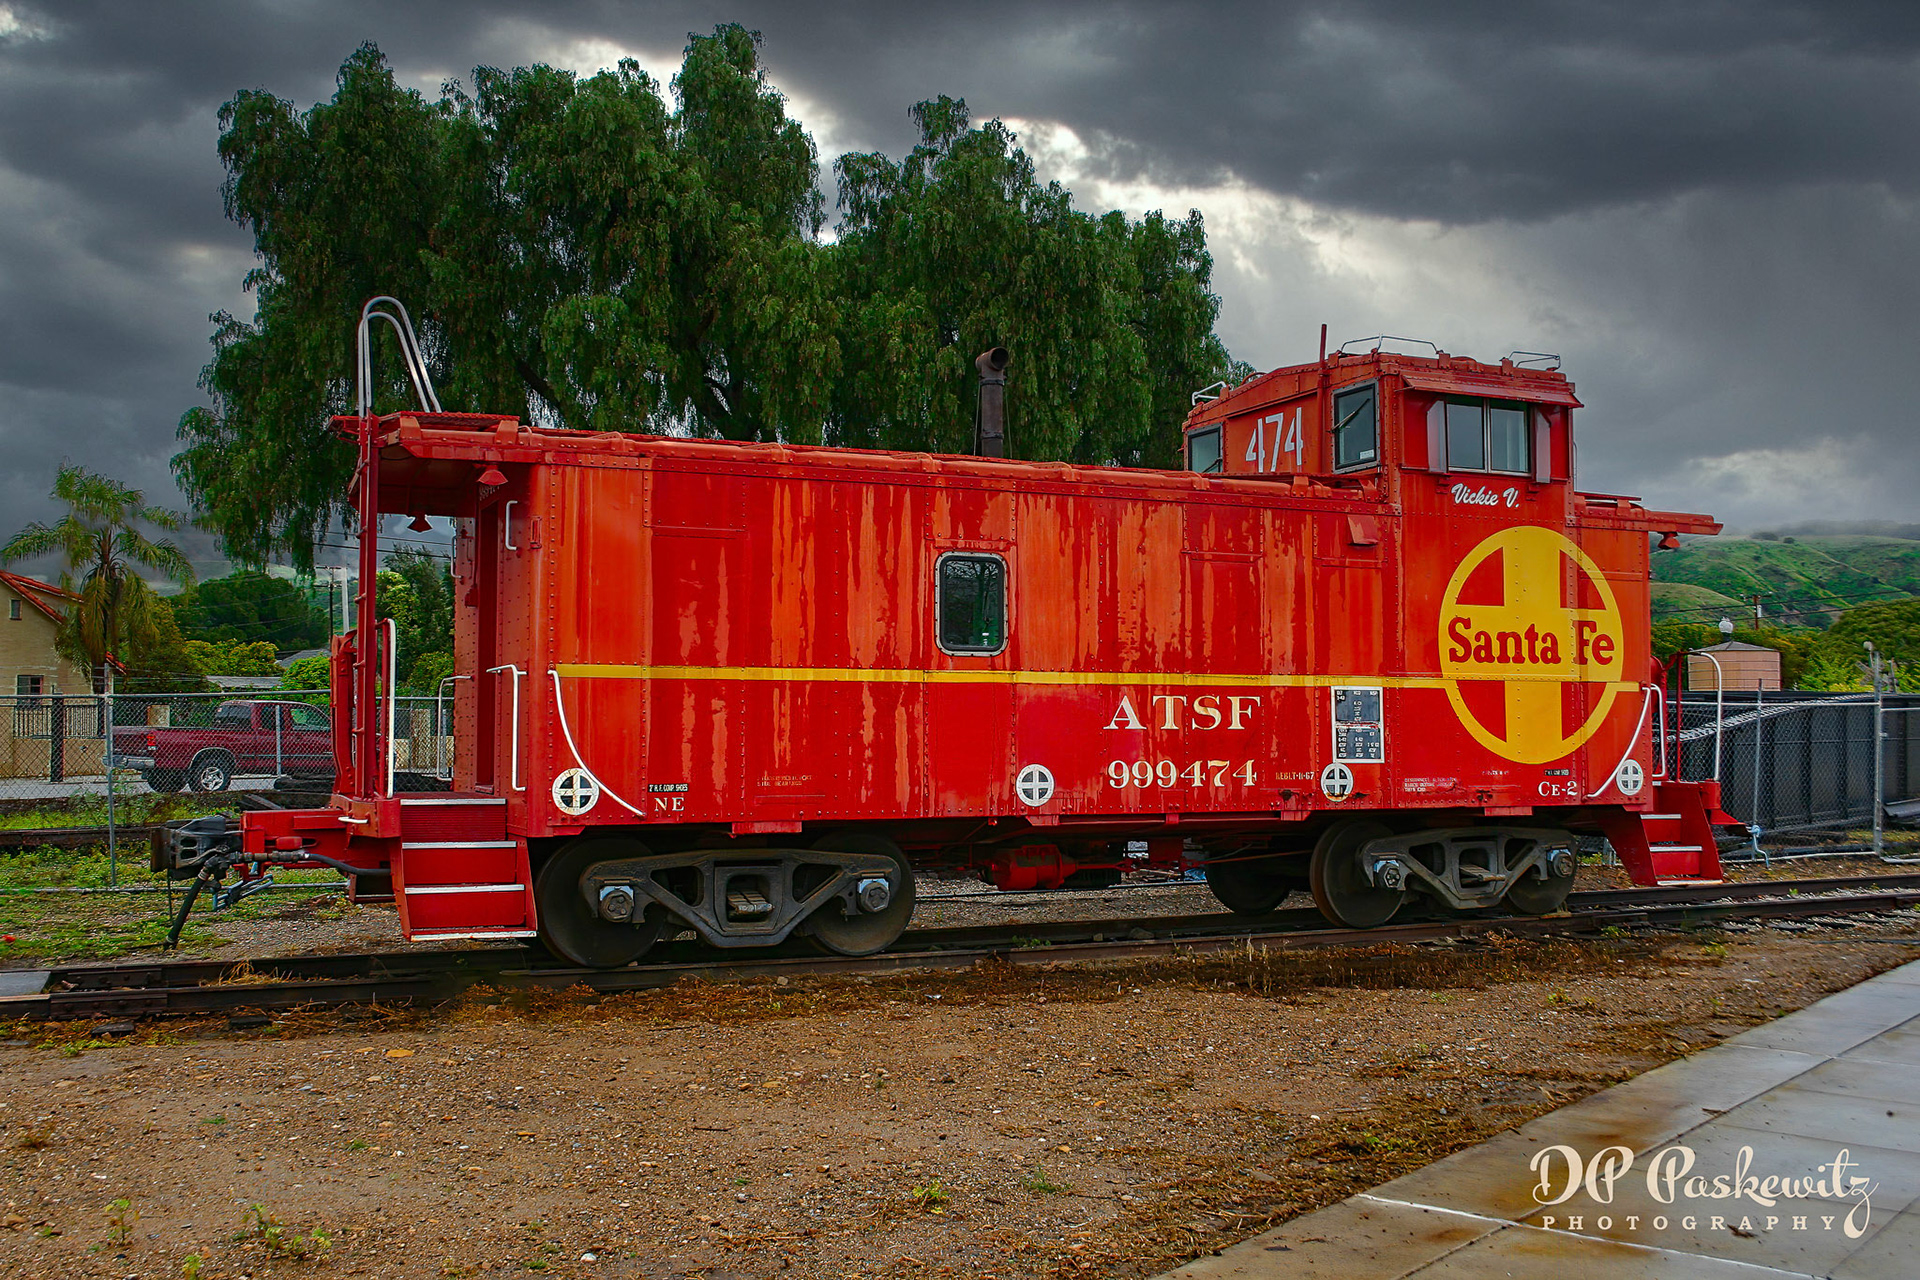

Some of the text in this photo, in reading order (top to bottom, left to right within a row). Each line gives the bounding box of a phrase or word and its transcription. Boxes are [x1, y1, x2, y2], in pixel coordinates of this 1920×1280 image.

[1245, 407, 1304, 473] 474
[1450, 482, 1520, 508] Vickie V.
[1448, 616, 1615, 665] Santa Fe
[1103, 695, 1260, 730] ATSF
[1108, 759, 1258, 789] 999474
[654, 797, 685, 812] NE
